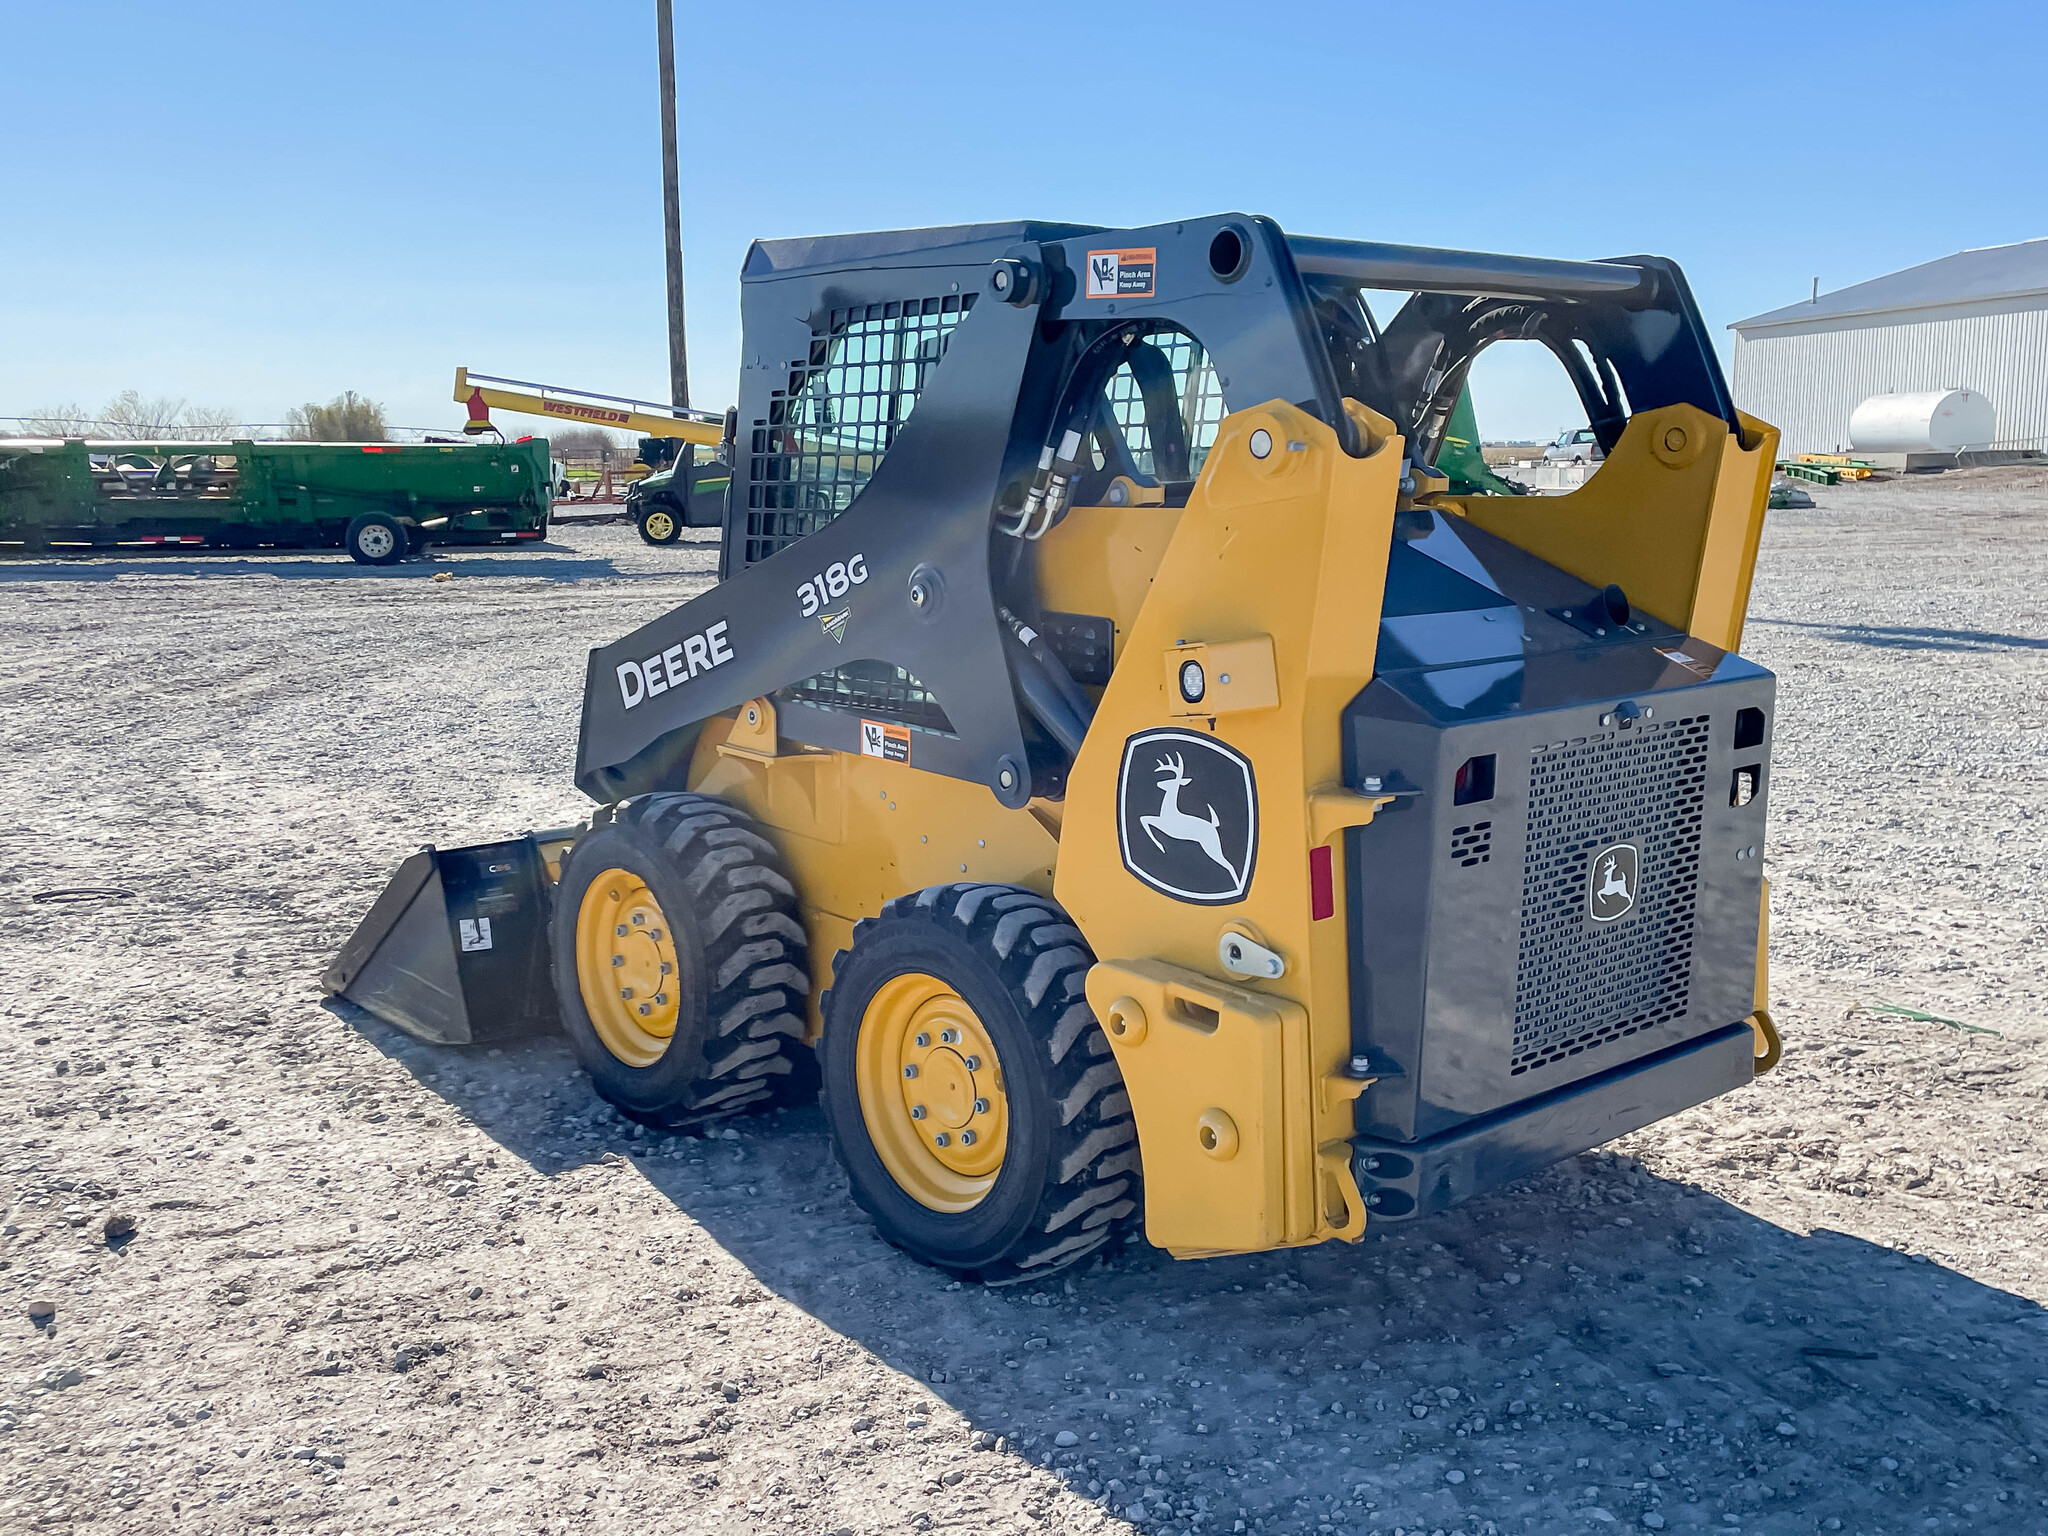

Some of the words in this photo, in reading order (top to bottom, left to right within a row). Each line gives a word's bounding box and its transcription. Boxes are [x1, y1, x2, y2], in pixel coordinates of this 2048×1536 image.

[1119, 271, 1137, 279] Pinch
[1137, 270, 1151, 278] Area
[543, 401, 618, 421] WESTFIELD
[796, 553, 869, 618] 318G
[616, 620, 734, 710] DEERE
